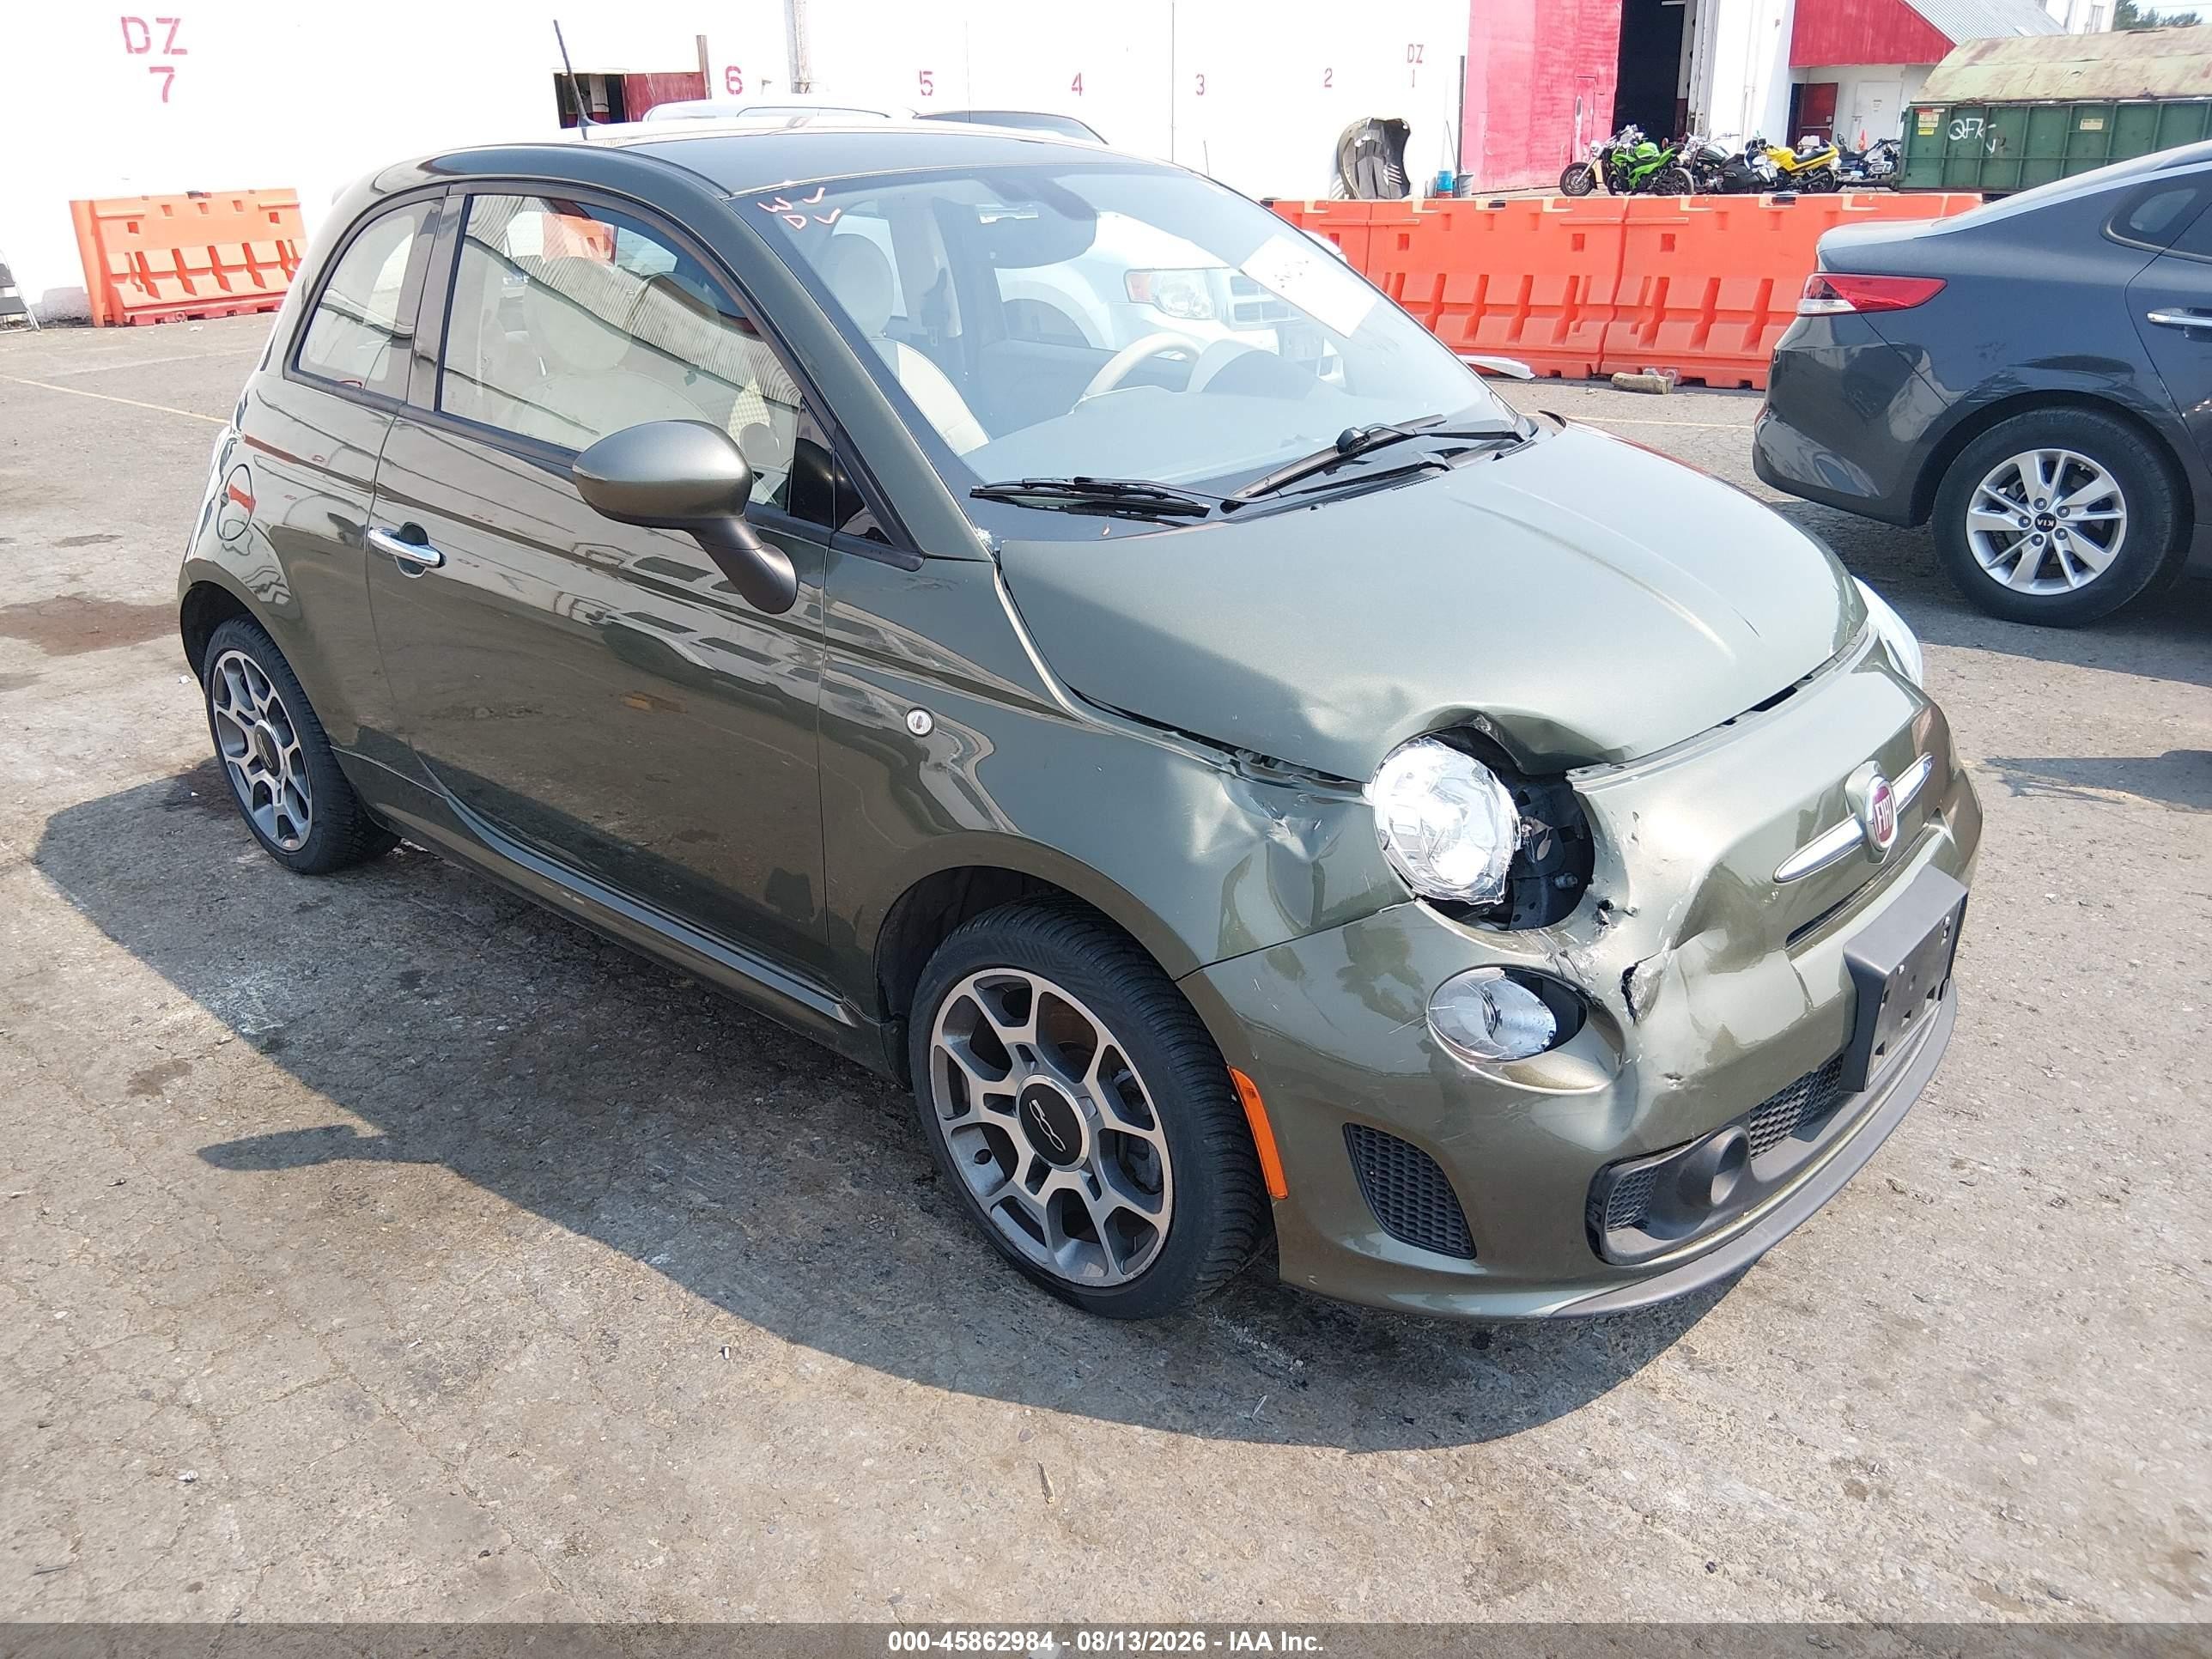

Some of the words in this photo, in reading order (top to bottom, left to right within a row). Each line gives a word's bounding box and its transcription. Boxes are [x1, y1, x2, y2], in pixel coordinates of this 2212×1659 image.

[120, 16, 187, 56] DZ
[1406, 43, 1426, 65] DZ
[149, 65, 176, 104] 7
[724, 64, 744, 96] 6
[919, 70, 934, 97] 5
[1071, 72, 1085, 97] 4
[1195, 73, 1206, 97] 3
[1323, 67, 1334, 88] 2
[2036, 518, 2056, 527] KIA
